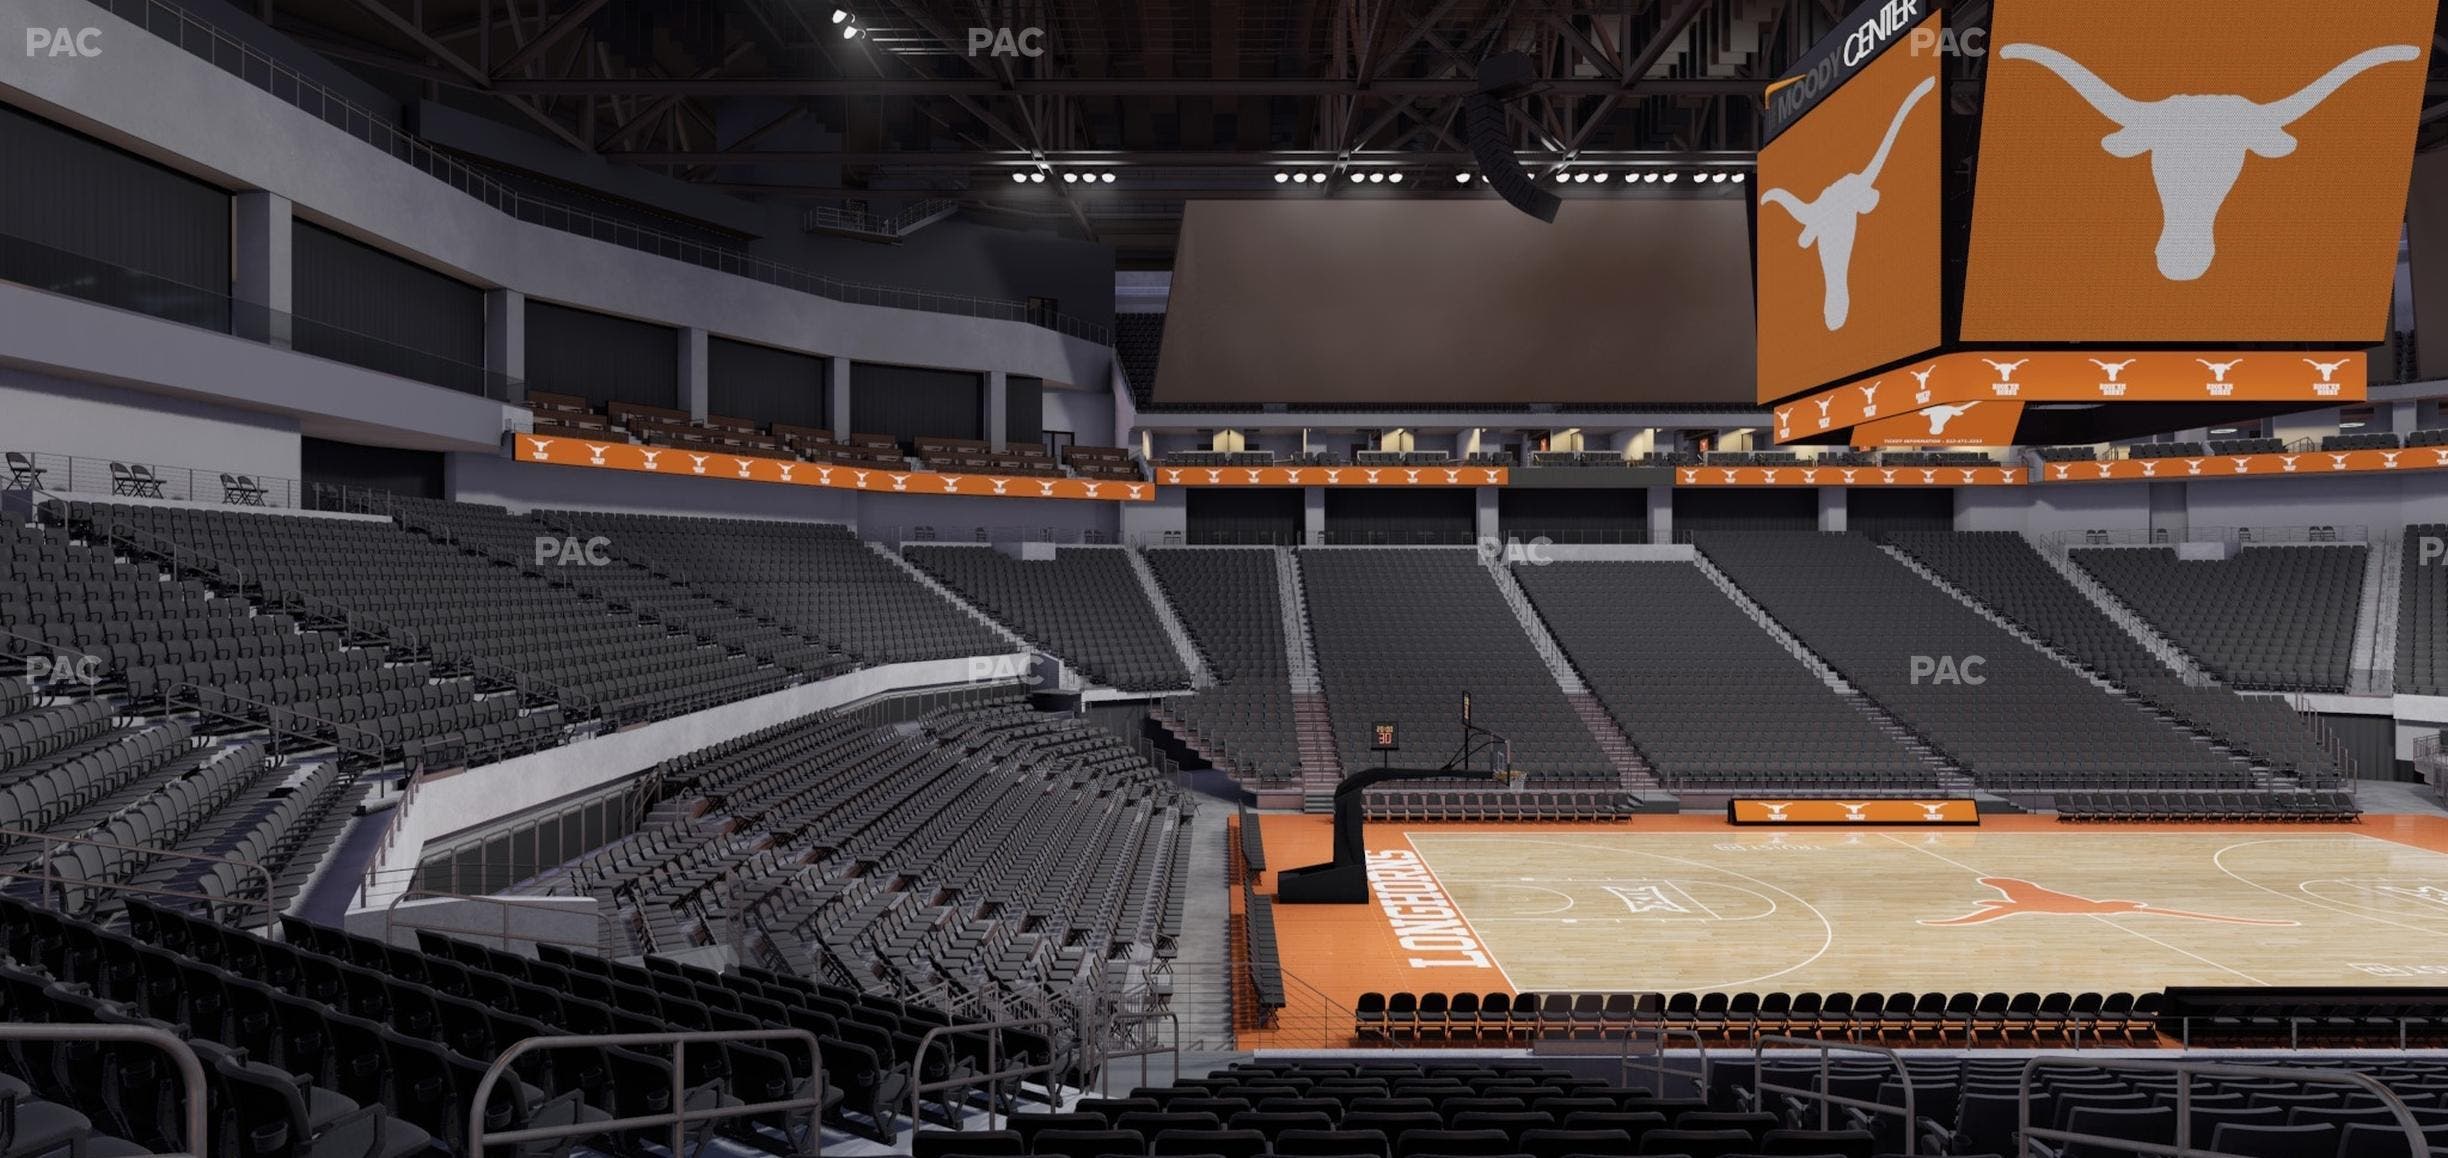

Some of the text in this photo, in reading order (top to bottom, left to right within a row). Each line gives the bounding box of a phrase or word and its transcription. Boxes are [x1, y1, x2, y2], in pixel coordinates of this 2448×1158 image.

[1777, 0, 1918, 124] MOODY CENTER
[1378, 732, 1392, 744] 30
[1365, 849, 1493, 969] LONGHORNS
